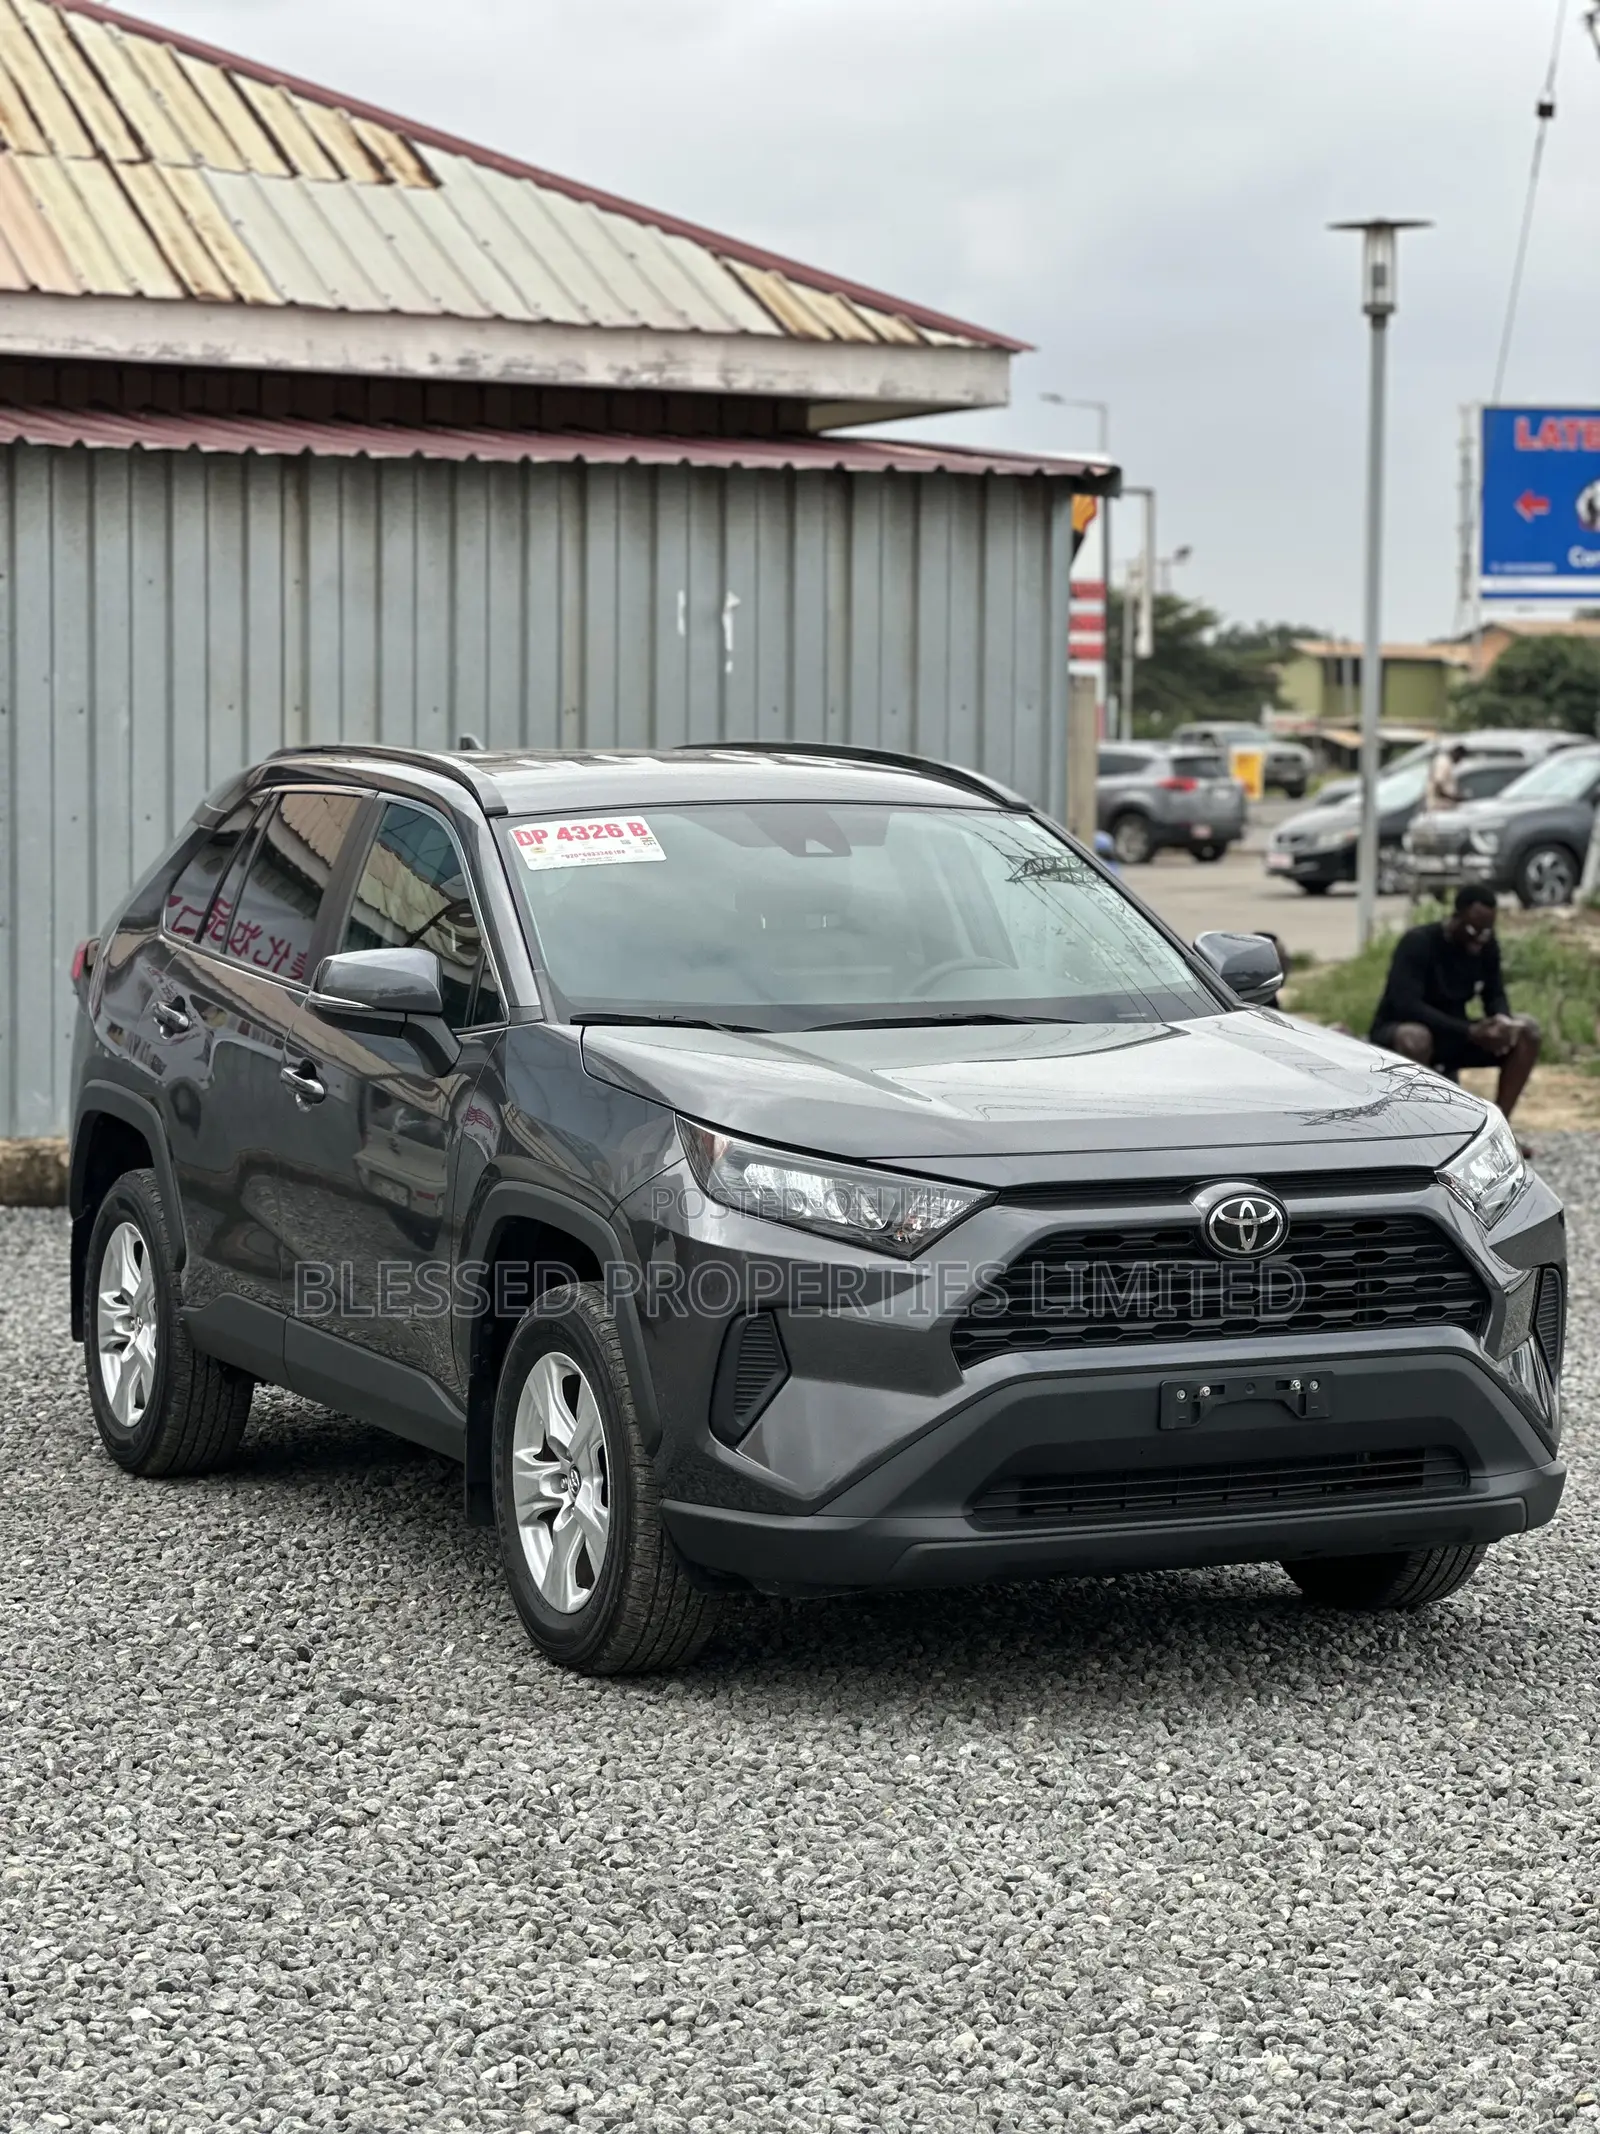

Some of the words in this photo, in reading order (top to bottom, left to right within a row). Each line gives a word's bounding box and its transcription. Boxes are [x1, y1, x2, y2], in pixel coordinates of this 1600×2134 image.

[513, 829, 549, 846] DP
[556, 823, 624, 842] 4326
[627, 822, 648, 837] B
